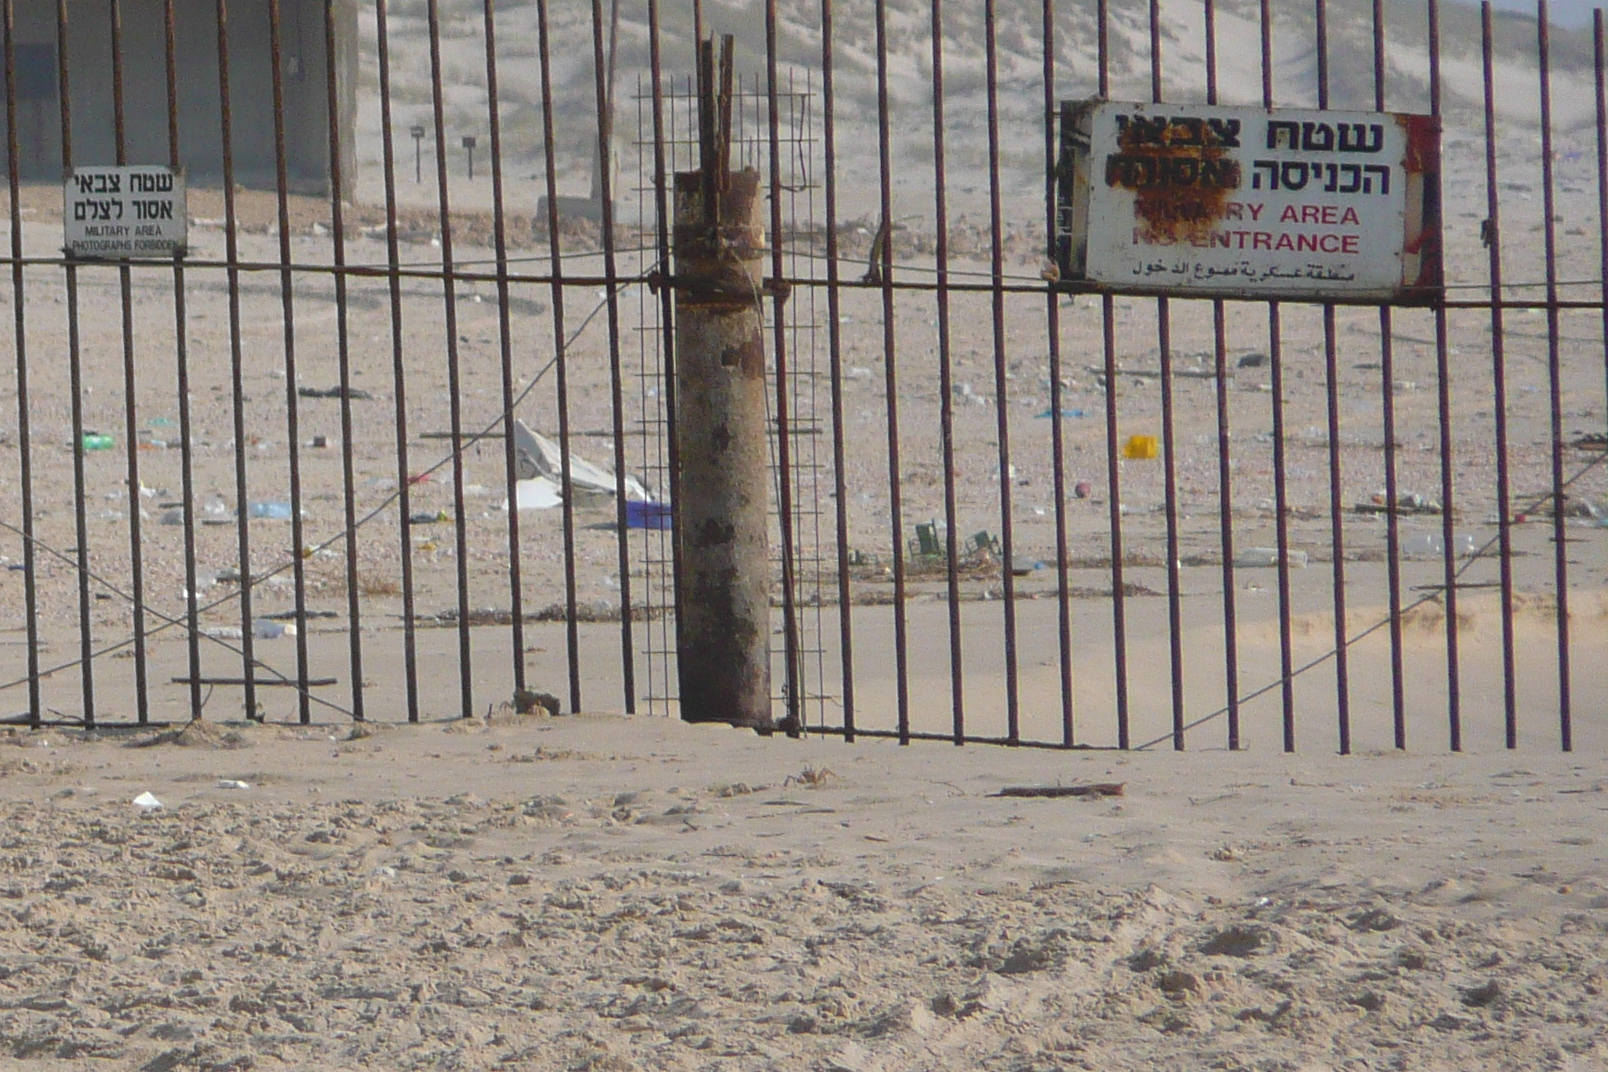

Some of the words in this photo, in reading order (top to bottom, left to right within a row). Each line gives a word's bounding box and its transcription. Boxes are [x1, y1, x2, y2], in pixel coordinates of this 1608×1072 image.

[1114, 114, 1241, 148] צבאי
[1266, 119, 1384, 152] שטח
[74, 174, 121, 193] צבאי
[129, 173, 173, 192] שטח
[1251, 159, 1390, 195] הכניסה
[74, 198, 123, 220] לצלם
[132, 200, 173, 220] אסור
[1278, 205, 1360, 226] AREA
[85, 225, 130, 237] MILITARY
[134, 225, 163, 237] AREA
[1189, 230, 1360, 254] ENTRANCE
